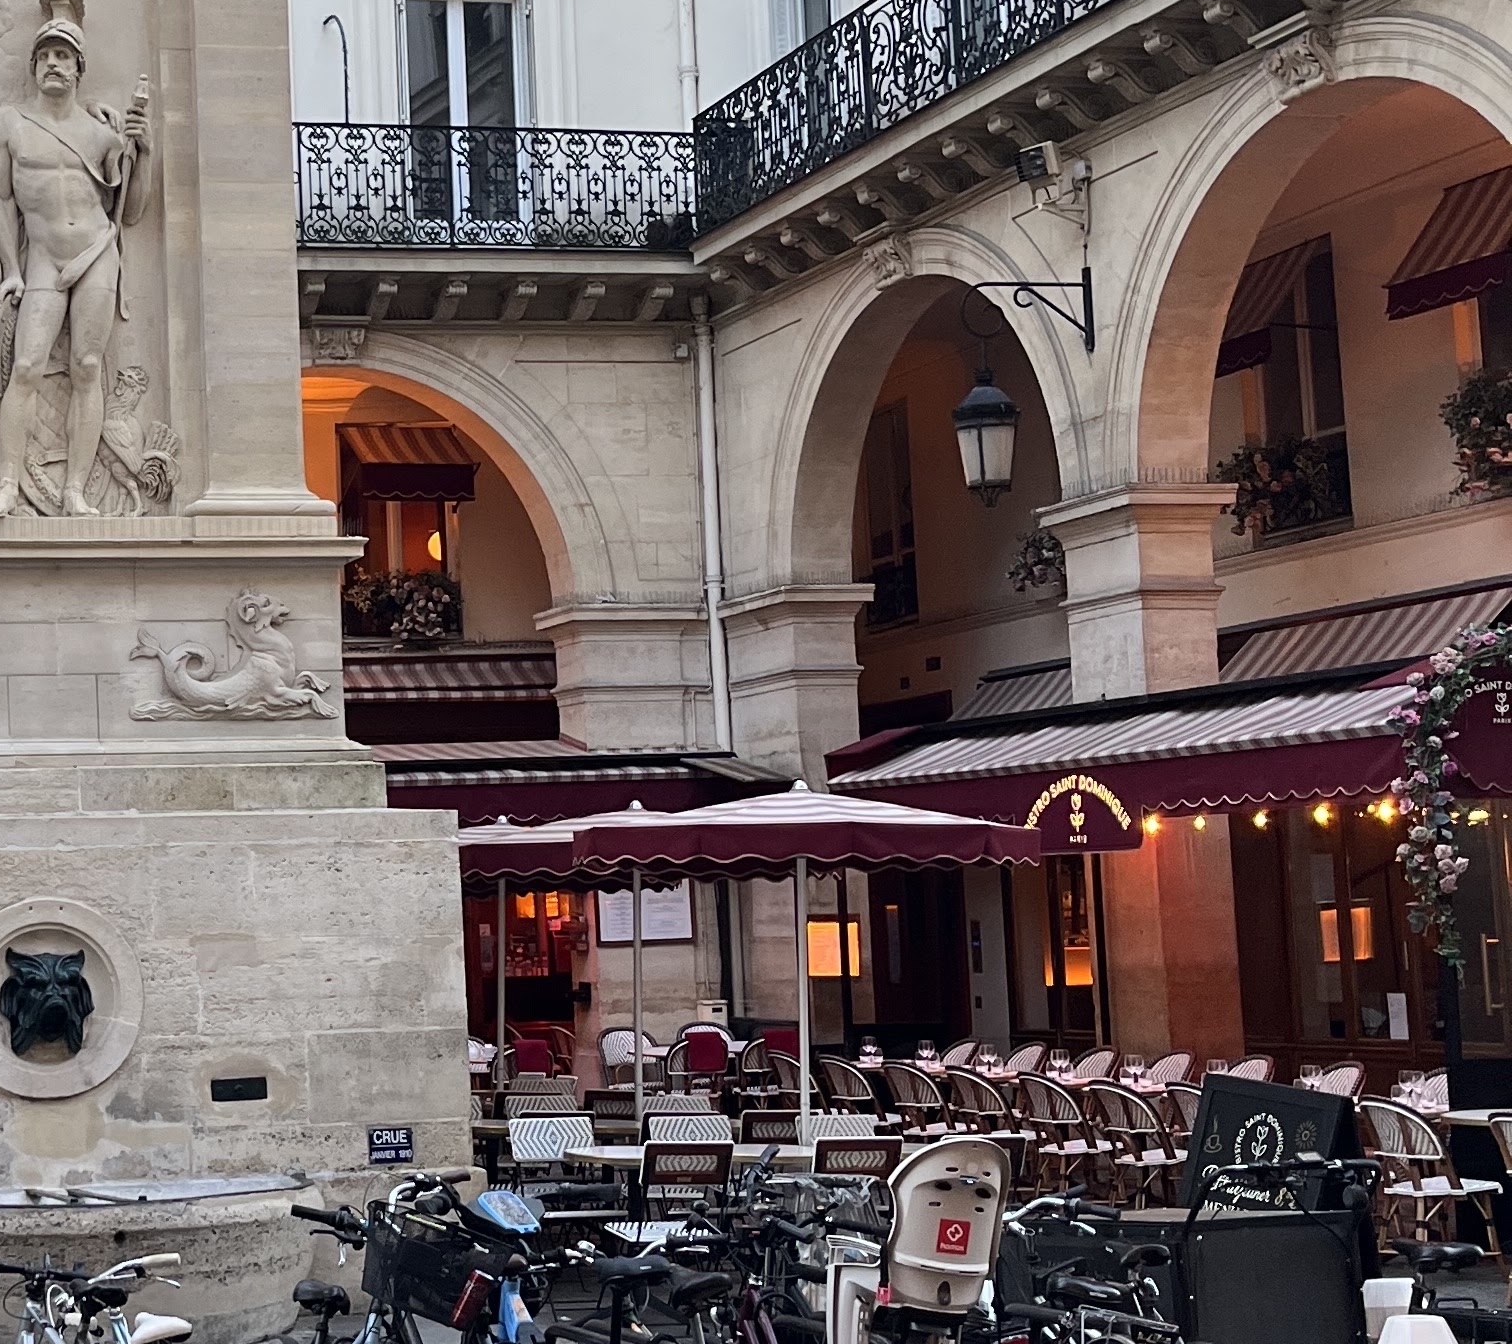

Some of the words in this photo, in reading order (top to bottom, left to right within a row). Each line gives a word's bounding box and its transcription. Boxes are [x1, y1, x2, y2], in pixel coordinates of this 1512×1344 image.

[1474, 680, 1503, 694] SAINT
[1049, 774, 1077, 799] SAINT
[1078, 774, 1132, 831] DOMINIQUE
[373, 1129, 408, 1144] CRUE
[1234, 1128, 1246, 1164] BISTRO
[1245, 1112, 1266, 1129] SAINT
[370, 1150, 396, 1159] JANVIER
